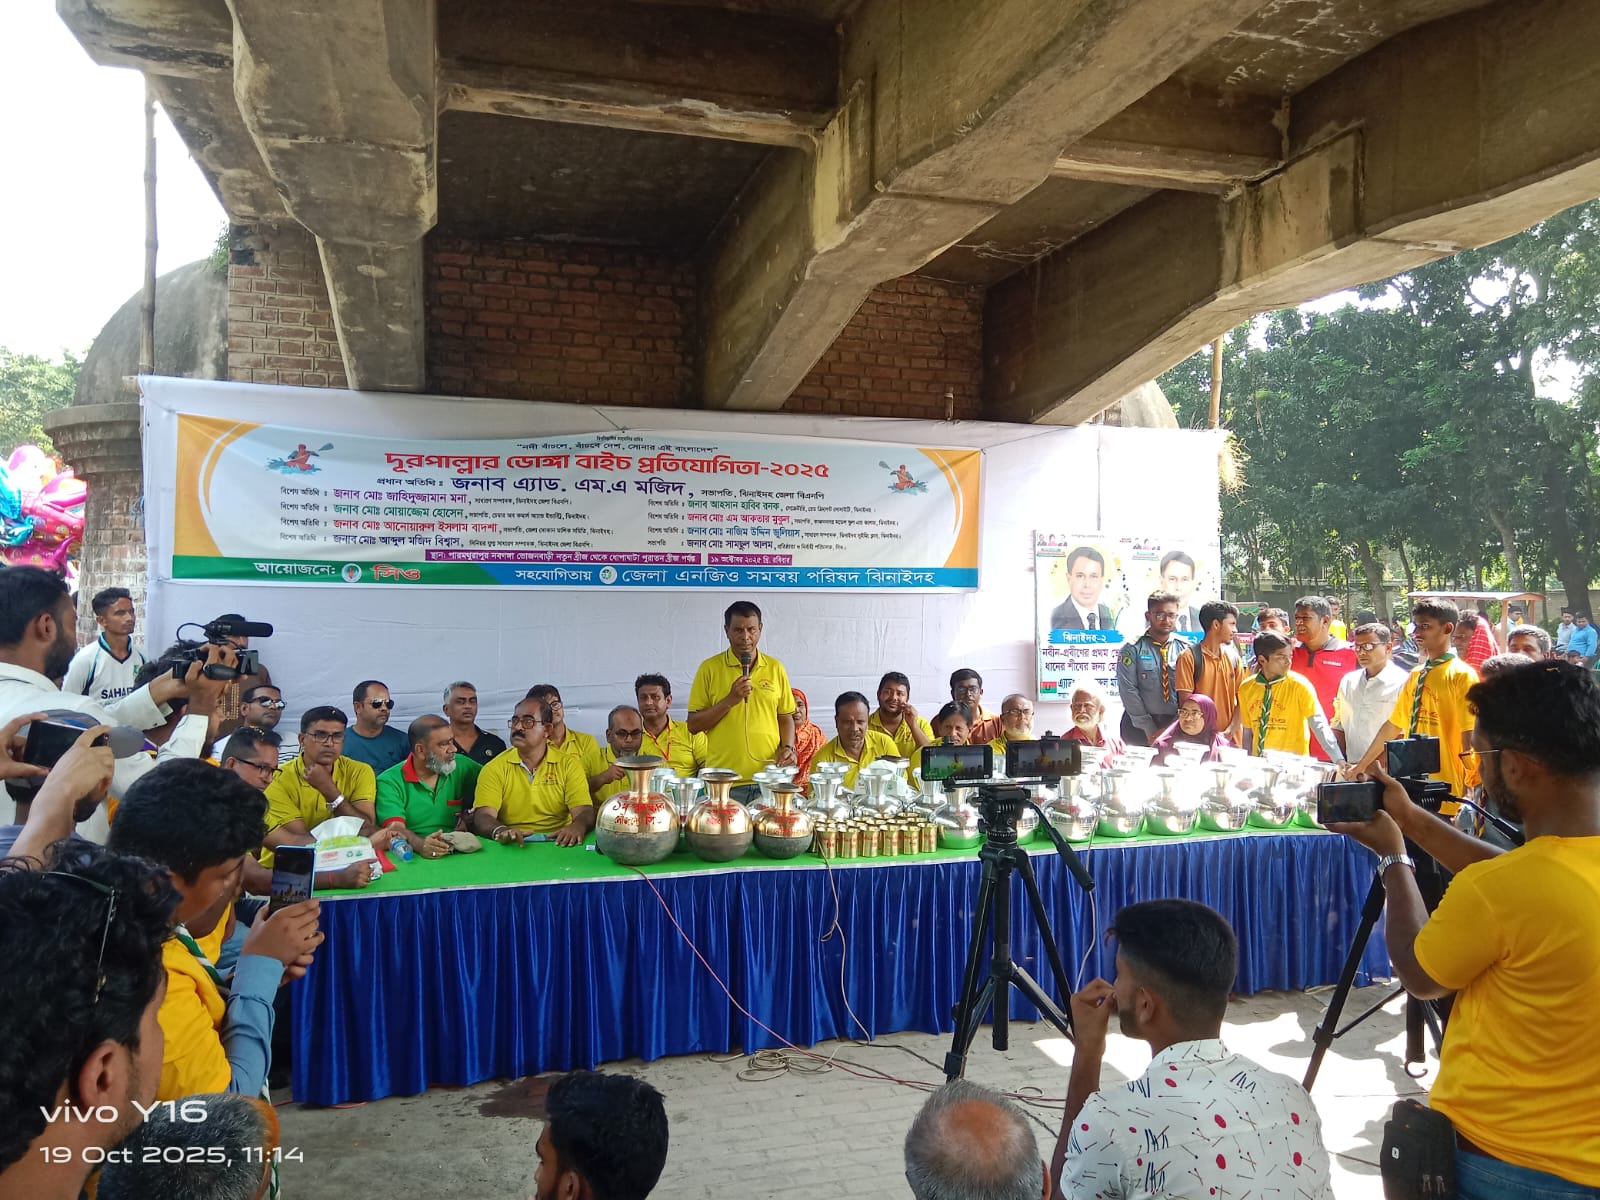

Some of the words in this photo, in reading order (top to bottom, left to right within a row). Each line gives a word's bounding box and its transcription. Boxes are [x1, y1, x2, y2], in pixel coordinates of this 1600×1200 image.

[385, 452, 500, 474] দূরপাল্লার
[506, 453, 570, 470] ডোঙ্গা
[575, 451, 633, 471] বাইচ
[638, 452, 829, 478] প্রতিযোগিতা-২০২৫
[280, 486, 299, 495] বিশেষ
[333, 488, 360, 499] জনাব
[363, 491, 383, 500] মোঃ
[386, 490, 447, 505] জাহিদুজ্জামান
[376, 478, 402, 486] প্রধান
[404, 478, 437, 487] অতিথি
[450, 477, 506, 492] জনাব
[513, 477, 567, 493] এ্যাড.
[575, 478, 627, 493] এম.এ
[739, 488, 773, 498] ঝিনাইদহ
[775, 491, 794, 499] জেলা
[797, 491, 825, 500] বিএনপি
[280, 502, 299, 511] বিশেষ
[333, 504, 359, 515] জনাব
[362, 506, 381, 516] মোঃ
[383, 507, 430, 518] মোয়াজ্জেম
[687, 500, 708, 510] জনাব
[710, 500, 738, 510] আহসান
[740, 499, 761, 510] হাবিব
[281, 517, 299, 526] বিশেষ
[333, 519, 359, 530] জনাব
[362, 521, 380, 531] মোঃ
[383, 521, 435, 533] আনোয়ারুল
[438, 520, 468, 532] ইসলাম
[687, 513, 708, 522] জনাব
[709, 514, 723, 522] মোঃ
[740, 515, 770, 524] আকতার
[687, 527, 707, 536] জনাব
[709, 527, 723, 536] মোঃ
[333, 534, 357, 545] জনাব
[359, 536, 376, 545] মোঃ
[379, 535, 405, 547] আব্দুল
[408, 534, 432, 545] মজিদ
[686, 540, 707, 549] জনাব
[708, 540, 723, 549] মোঃ
[371, 563, 421, 581] সিও
[514, 567, 592, 581] সহযোগিতায়
[622, 569, 668, 583] জেলা
[675, 567, 739, 583] এনজিও
[746, 570, 800, 584] সমন্বয়
[806, 569, 861, 584] পরিষদ
[865, 569, 935, 584] ঝিনাইদহ
[1045, 662, 1065, 671] ধানের
